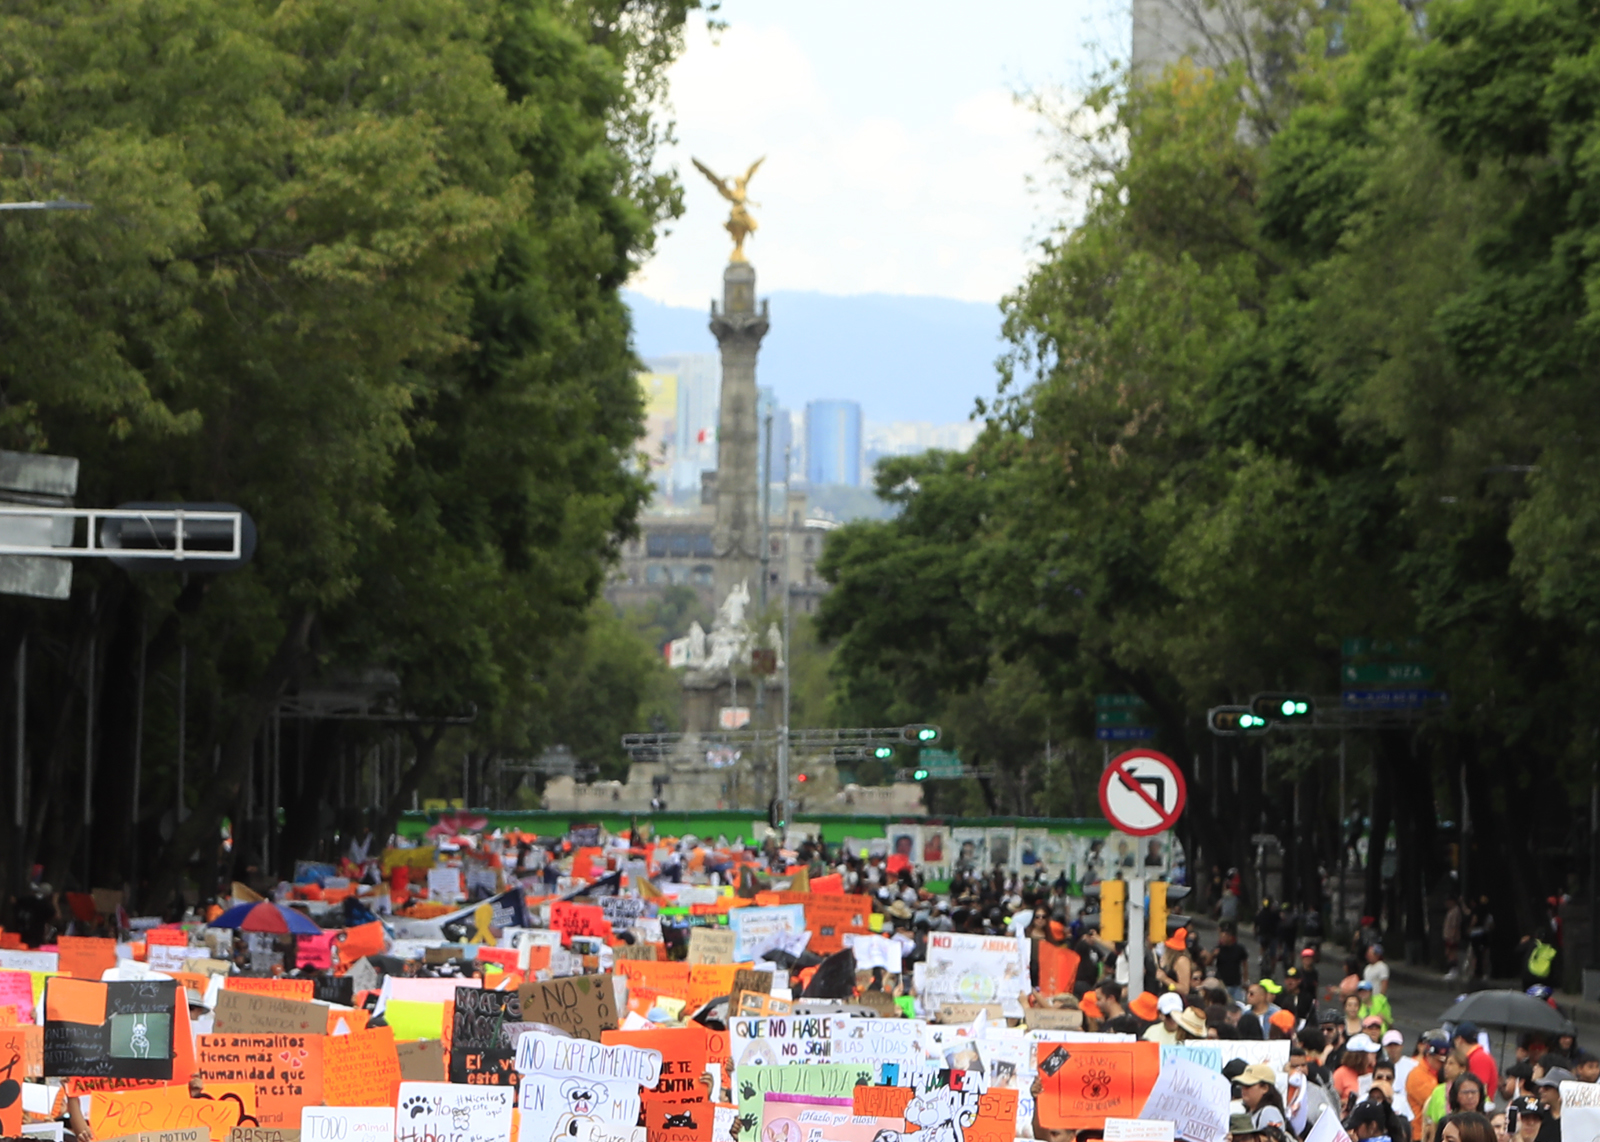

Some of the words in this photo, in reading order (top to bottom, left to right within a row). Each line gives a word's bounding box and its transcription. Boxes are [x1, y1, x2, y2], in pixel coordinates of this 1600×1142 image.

[541, 980, 578, 1009] NO
[736, 1018, 765, 1039] QUE
[769, 1019, 786, 1038] NO
[201, 1036, 227, 1048] Los
[231, 1035, 305, 1048] animalitos
[201, 1052, 240, 1062] tienen
[245, 1049, 272, 1063] más
[782, 1043, 798, 1057] NO
[553, 1040, 660, 1083] EXPERIMENTES
[200, 1067, 275, 1080] humanidad
[281, 1069, 305, 1083] que
